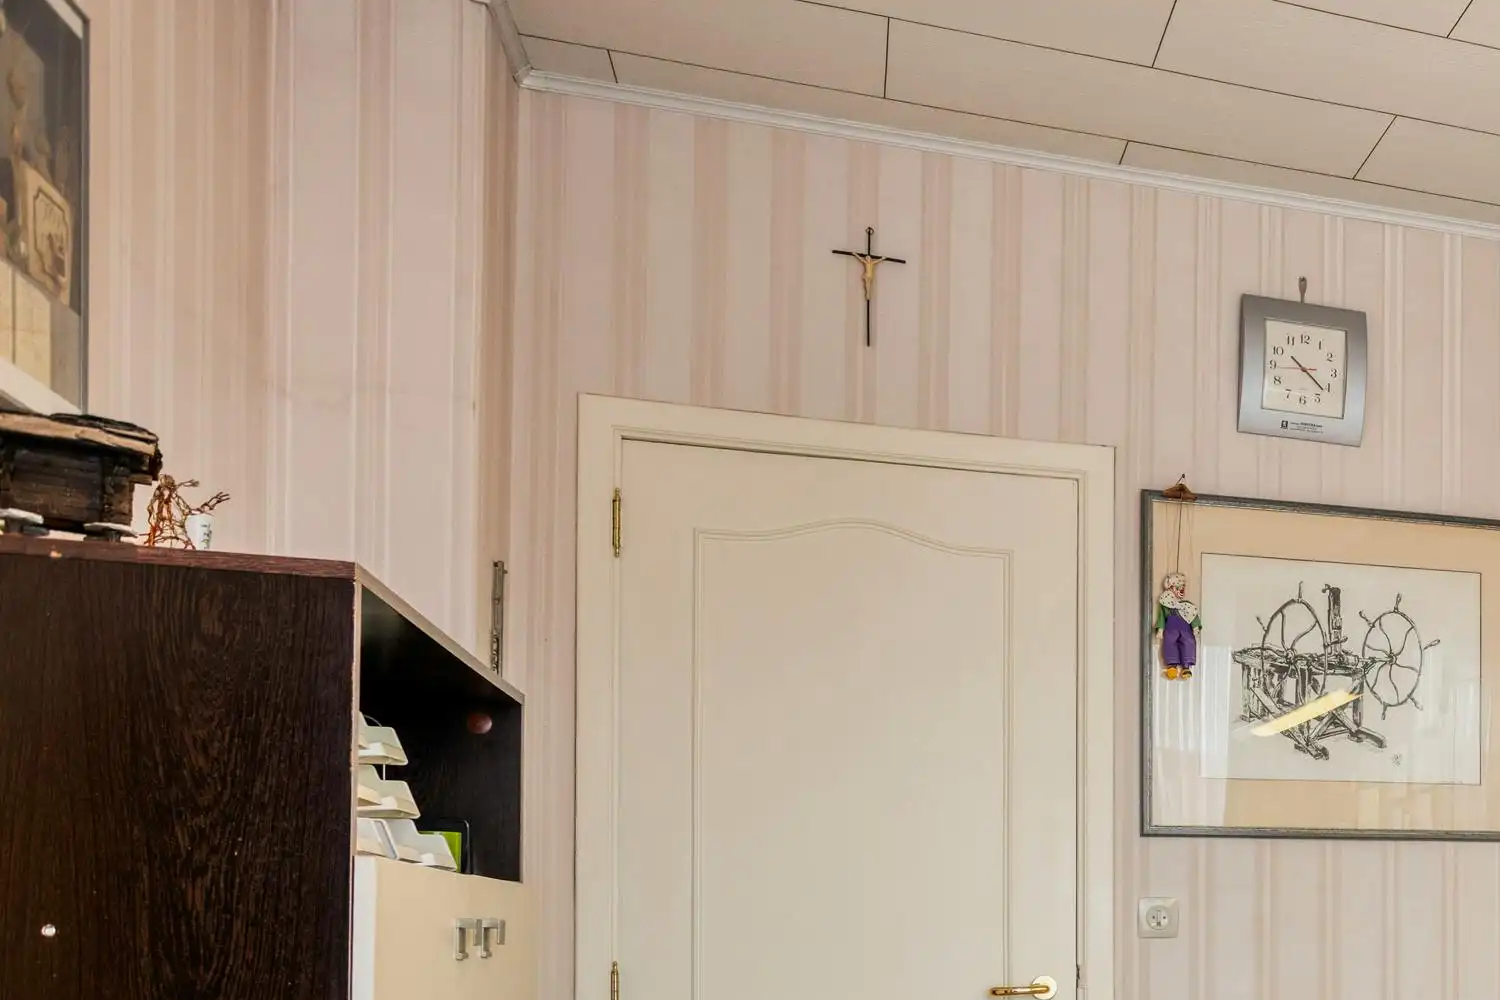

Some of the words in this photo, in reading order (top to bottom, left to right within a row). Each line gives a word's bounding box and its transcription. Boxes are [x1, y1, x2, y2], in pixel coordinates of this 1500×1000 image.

[1286, 335, 1295, 346] 11
[1300, 333, 1311, 345] 12
[1272, 345, 1284, 356] 10
[1326, 352, 1333, 362] 2
[1269, 359, 1277, 369] 9
[1330, 368, 1338, 379] 3
[1273, 375, 1282, 386] 8
[1325, 382, 1331, 393] 4
[1285, 388, 1292, 399] 7
[1313, 392, 1321, 403] 5
[1299, 395, 1307, 405] 6
